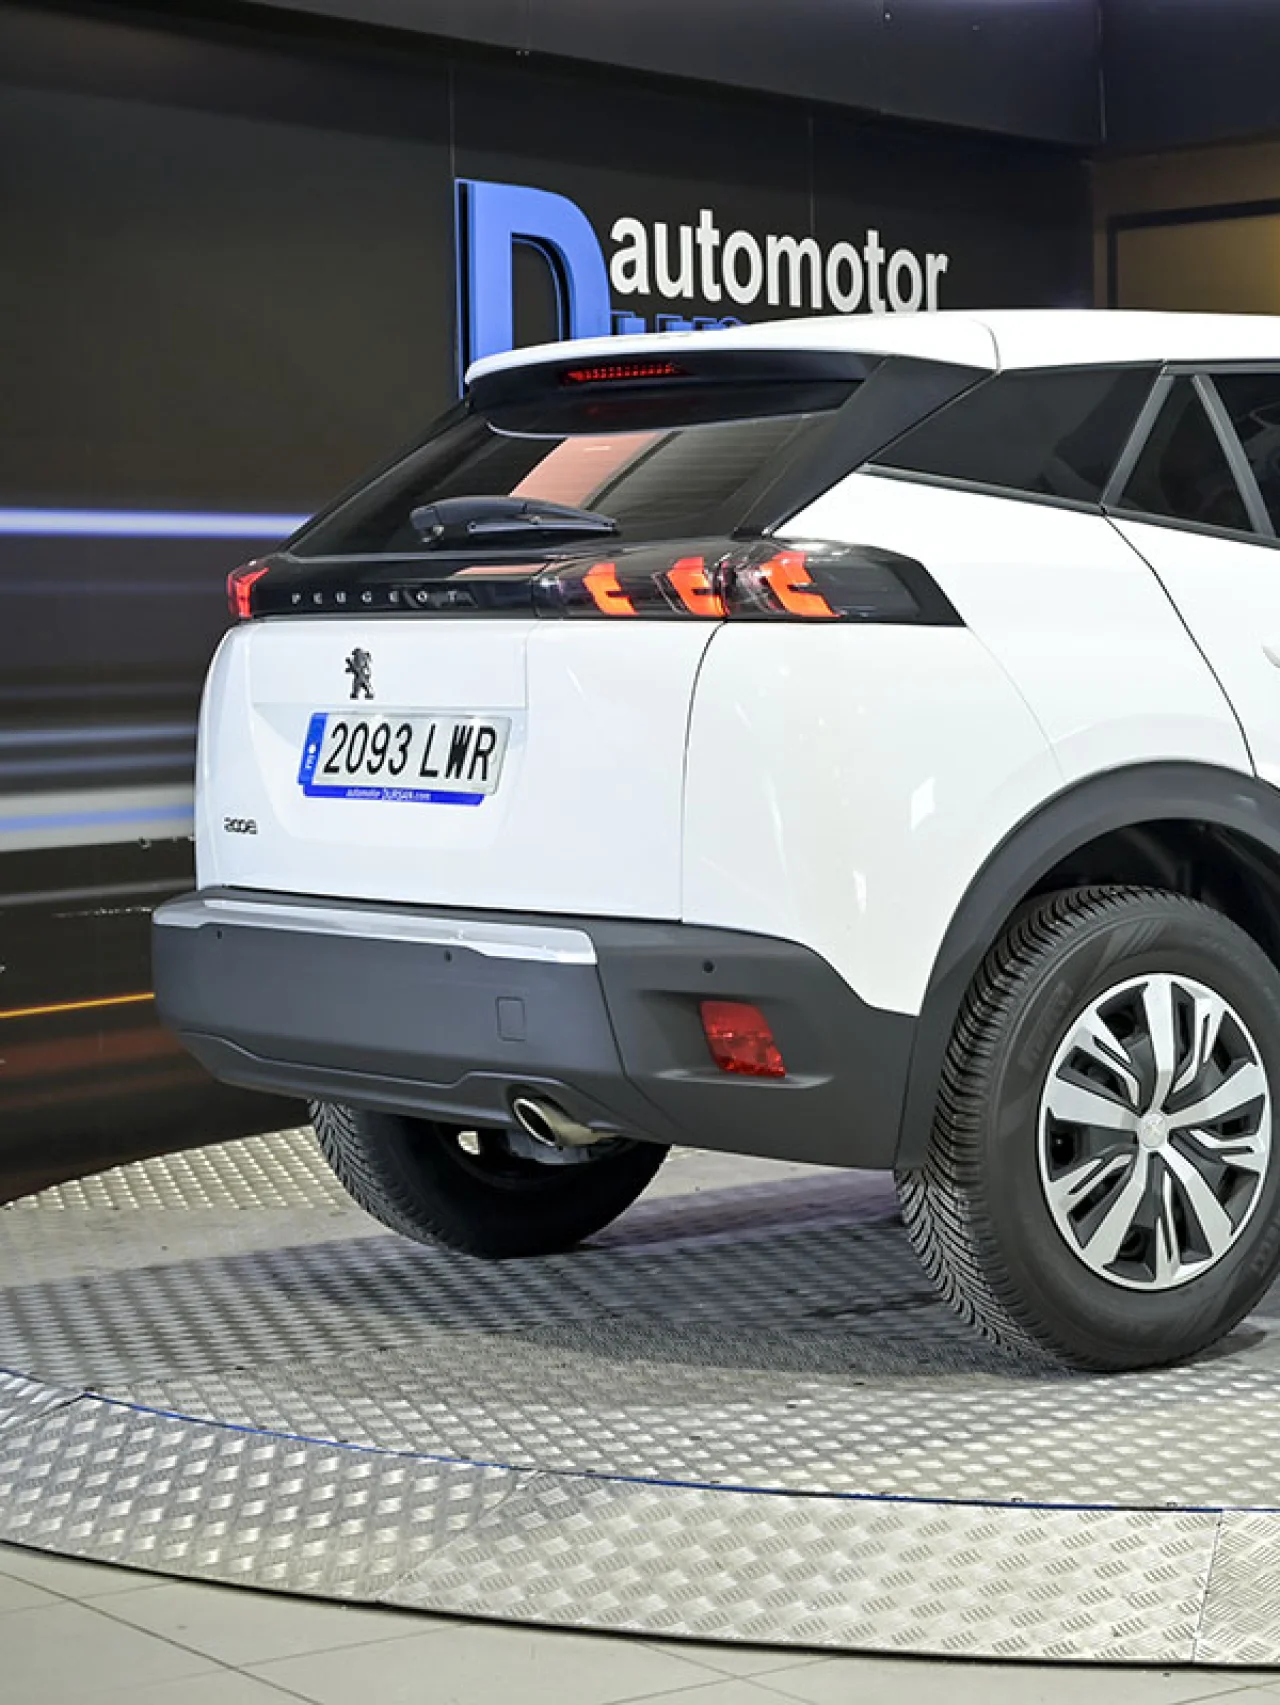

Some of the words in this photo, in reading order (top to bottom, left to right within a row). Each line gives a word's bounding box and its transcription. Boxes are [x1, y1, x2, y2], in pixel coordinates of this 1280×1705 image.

[610, 209, 949, 312] automotor
[291, 590, 458, 605] PEUGEOT
[323, 721, 413, 776] 2093
[419, 722, 497, 782] LWR
[223, 816, 258, 835] 2008
